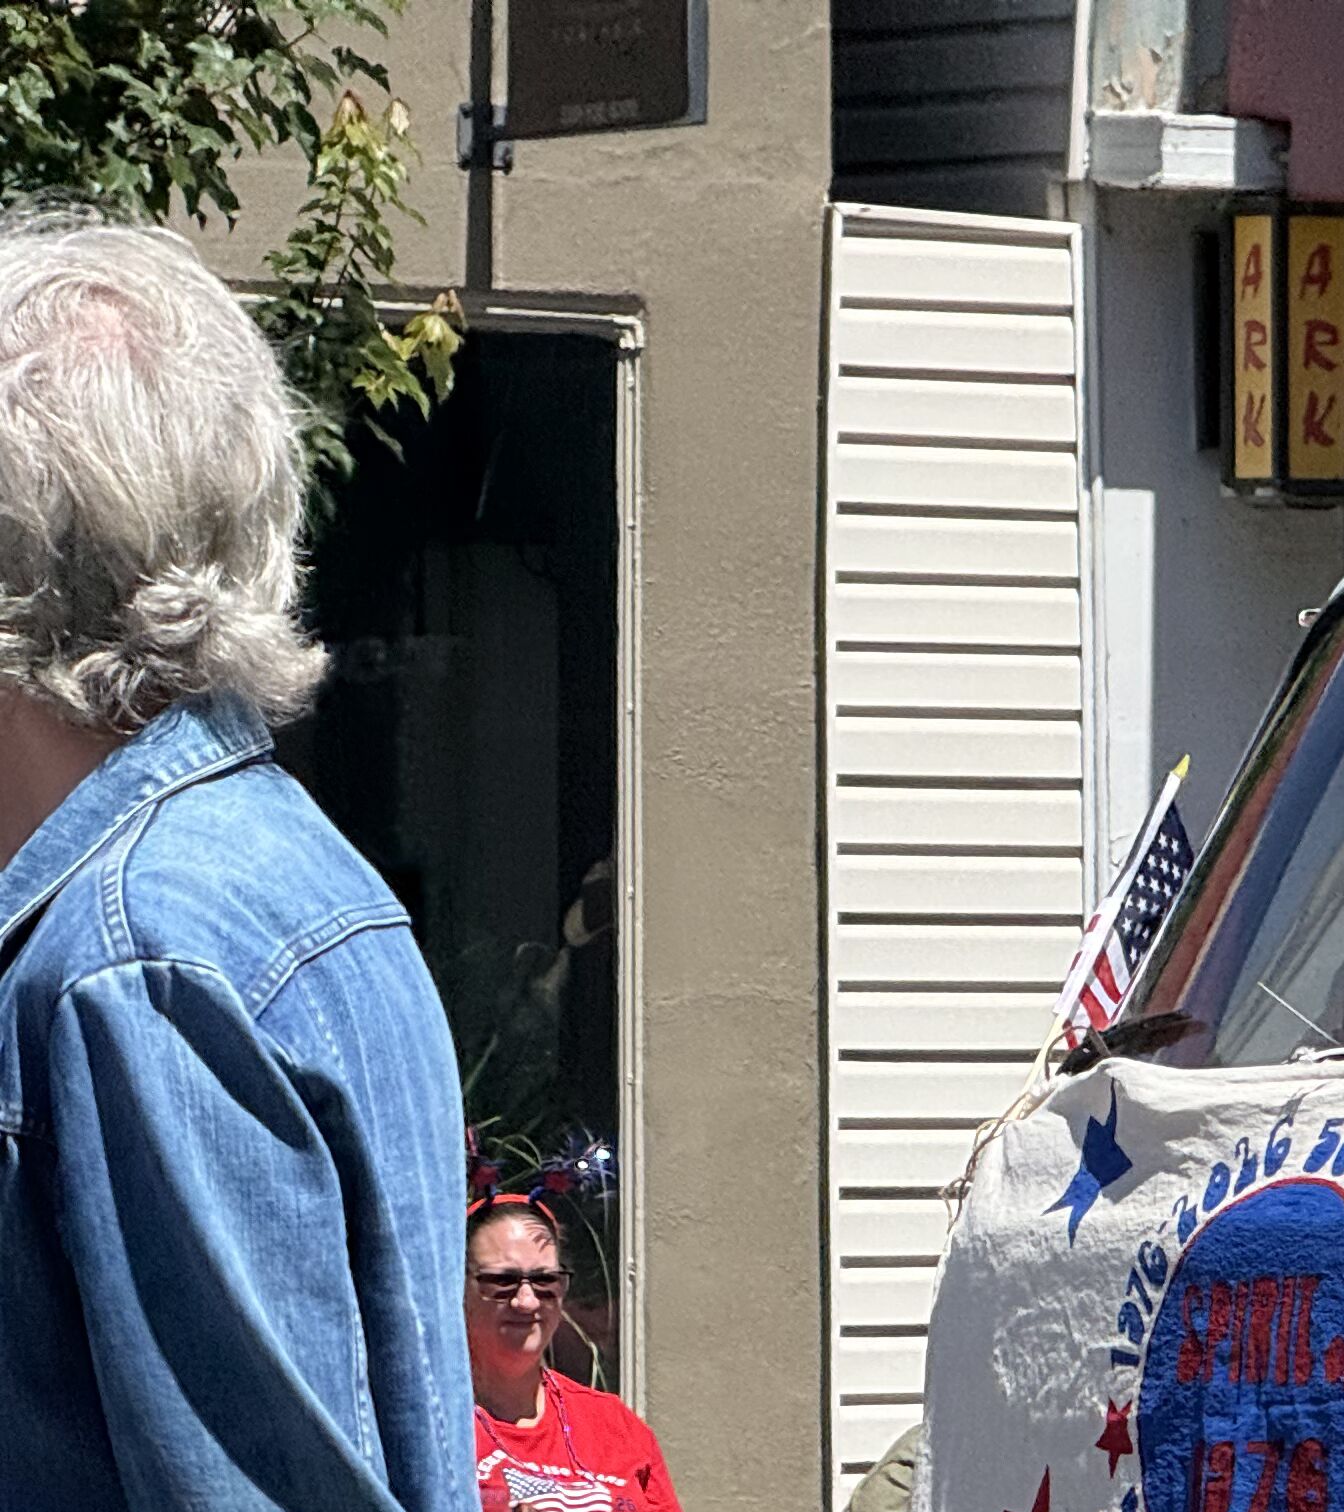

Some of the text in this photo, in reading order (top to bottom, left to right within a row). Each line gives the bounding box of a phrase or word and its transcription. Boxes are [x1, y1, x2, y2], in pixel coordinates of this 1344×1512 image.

[1241, 243, 1268, 448] ARK
[1300, 242, 1341, 448] ARK
[1175, 1275, 1324, 1388] SPIRIT
